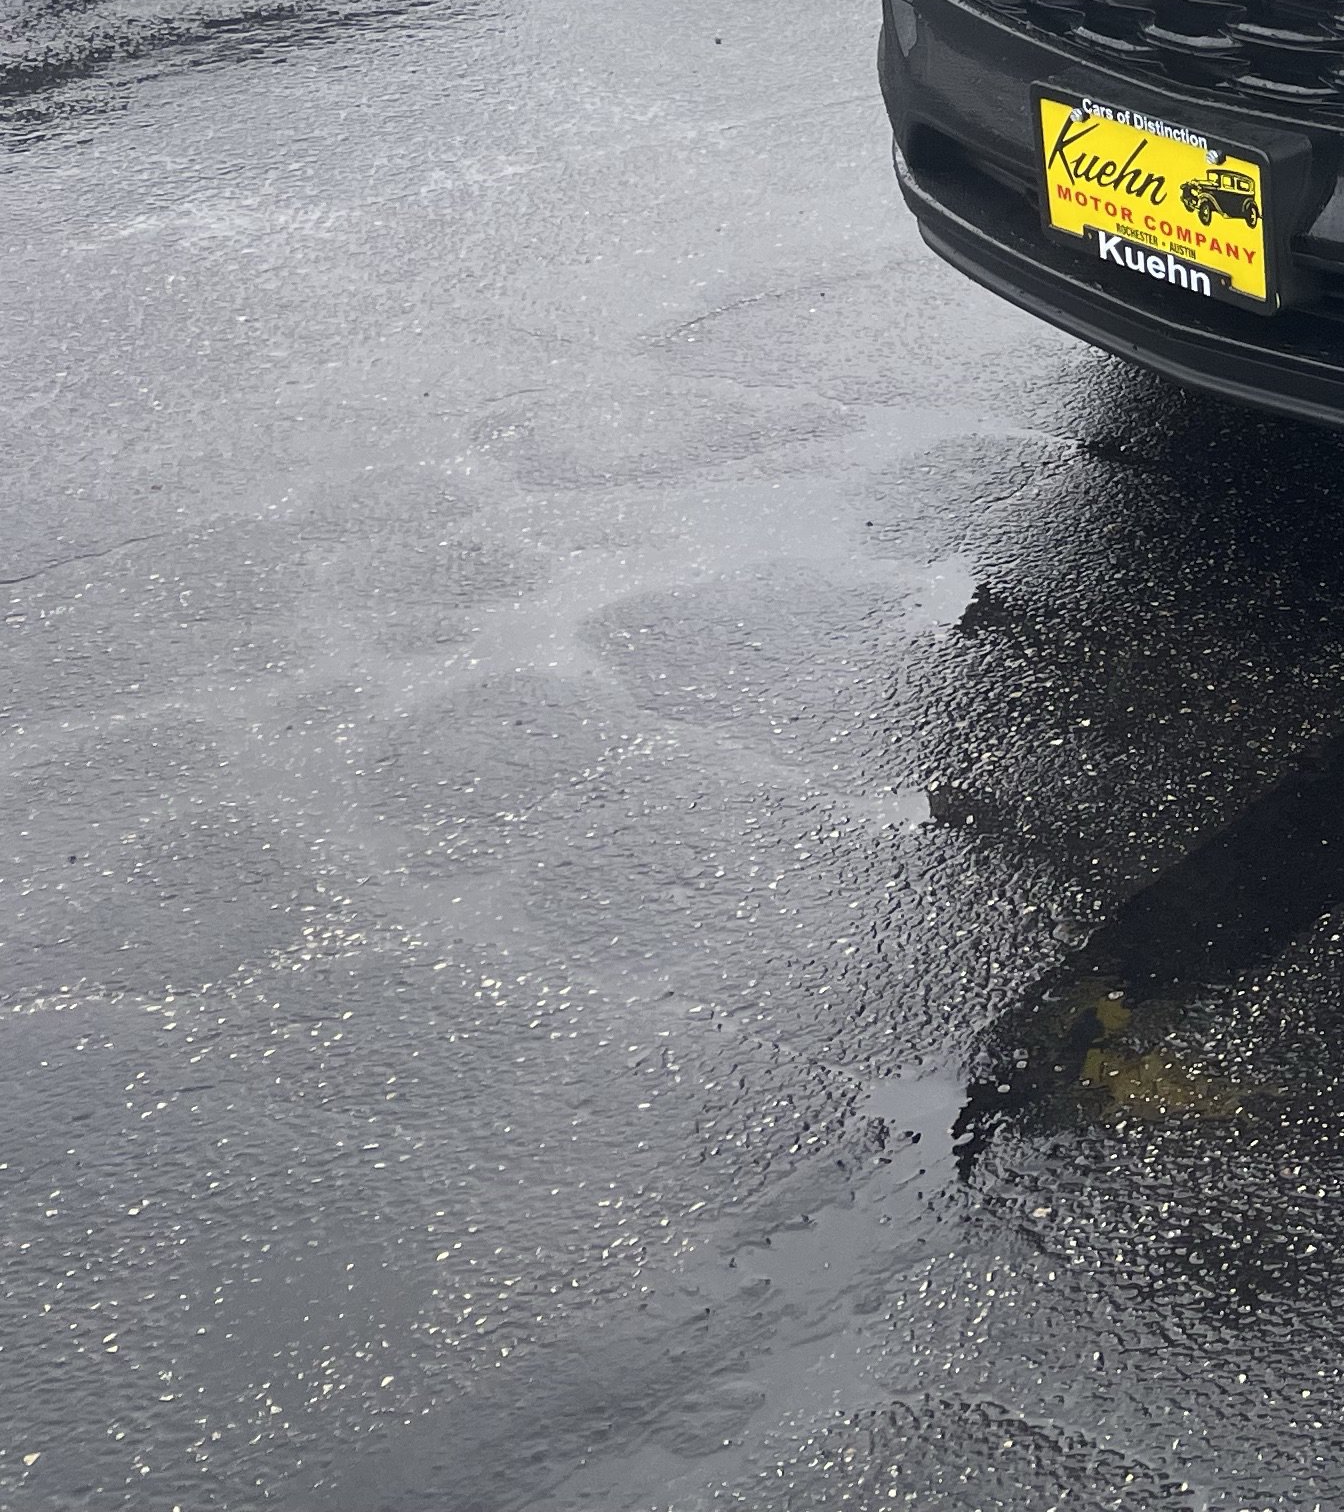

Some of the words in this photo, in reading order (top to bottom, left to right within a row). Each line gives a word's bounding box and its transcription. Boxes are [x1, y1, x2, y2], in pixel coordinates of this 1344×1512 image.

[1082, 98, 1114, 121] Cars
[1117, 110, 1132, 126] of
[1134, 114, 1209, 149] Distinction
[1048, 112, 1168, 206] Kuehn
[1056, 184, 1134, 223] MOTOR
[1144, 215, 1257, 265] COMPANY
[1115, 222, 1159, 248] ROCHESTER
[1169, 242, 1197, 260] AUSTIN
[1098, 230, 1212, 297] Kuehn
